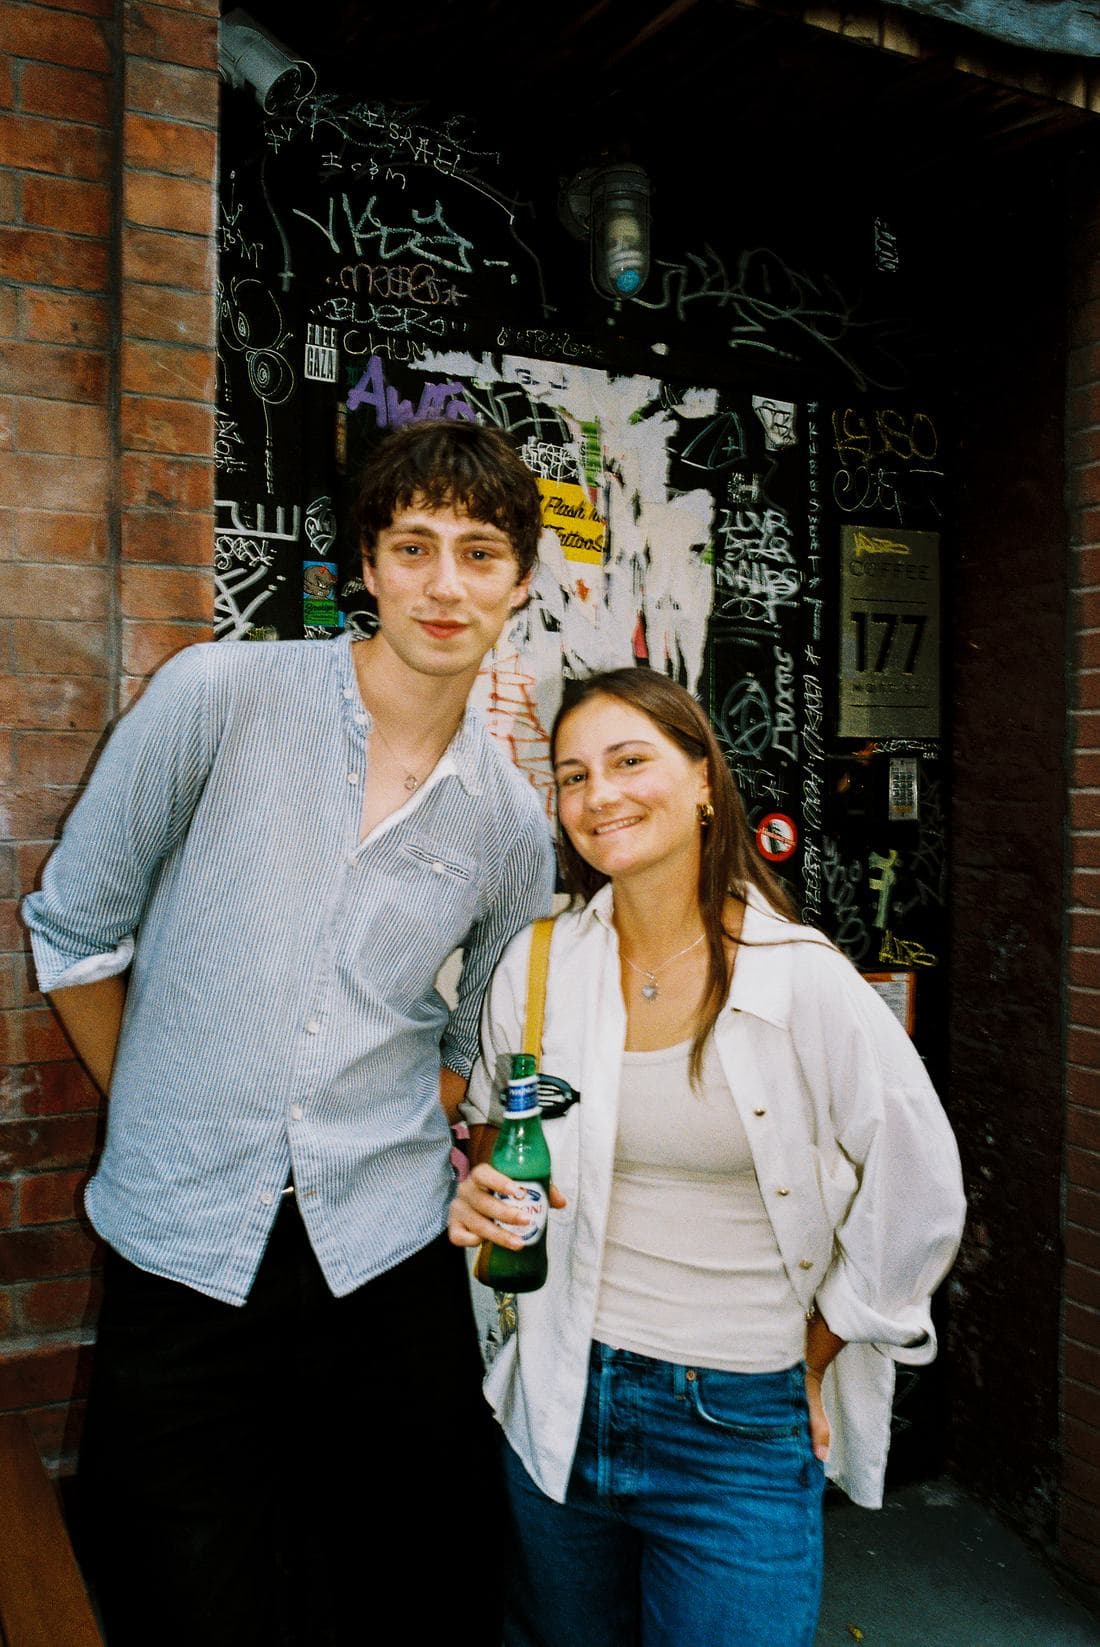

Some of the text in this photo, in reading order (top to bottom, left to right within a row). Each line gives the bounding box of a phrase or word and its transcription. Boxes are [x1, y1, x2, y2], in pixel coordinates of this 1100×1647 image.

[307, 323, 336, 348] FREE
[848, 559, 931, 581] COFFEE
[850, 611, 928, 675] 177
